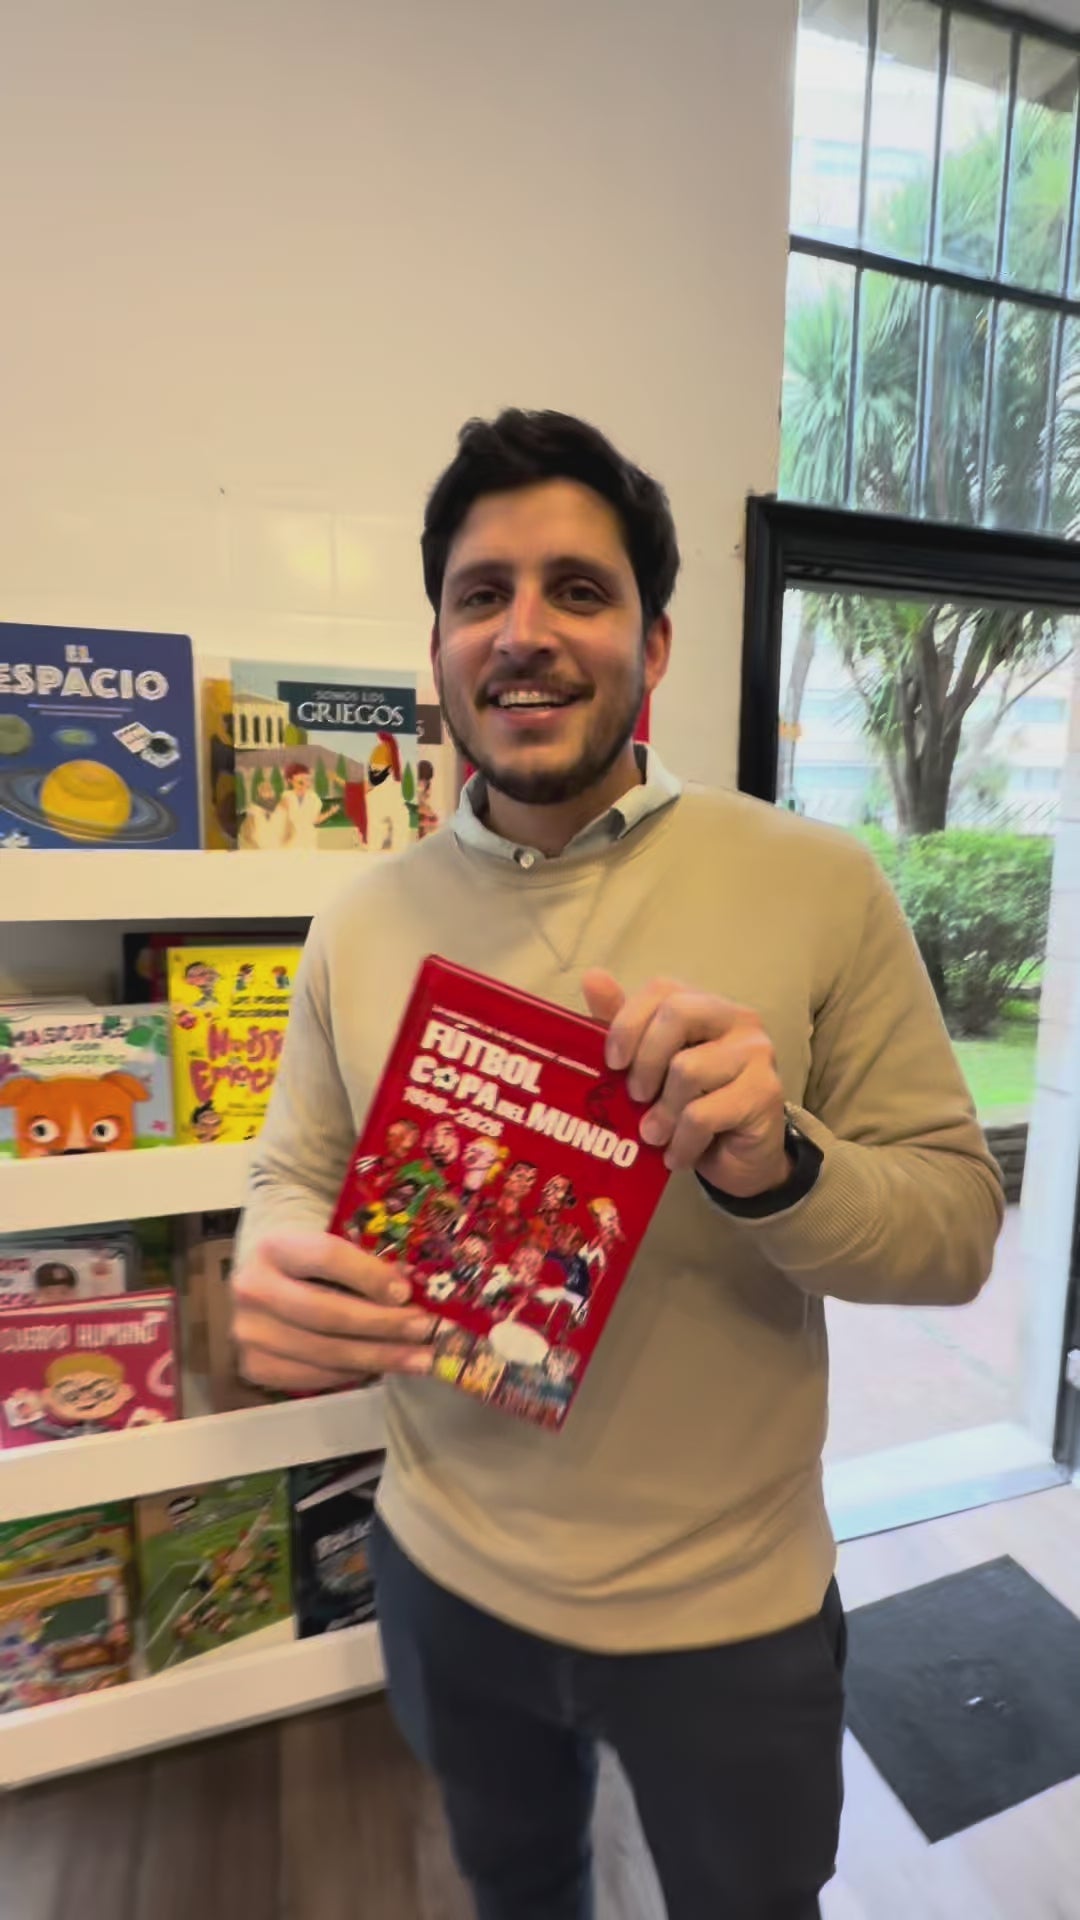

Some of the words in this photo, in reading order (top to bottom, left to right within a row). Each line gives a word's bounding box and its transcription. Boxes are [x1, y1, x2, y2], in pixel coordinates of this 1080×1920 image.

[65, 644, 93, 663] EL
[0, 663, 169, 700] ESPACIO
[297, 701, 404, 727] GRIEGOS
[525, 1101, 639, 1168] MUNDO
